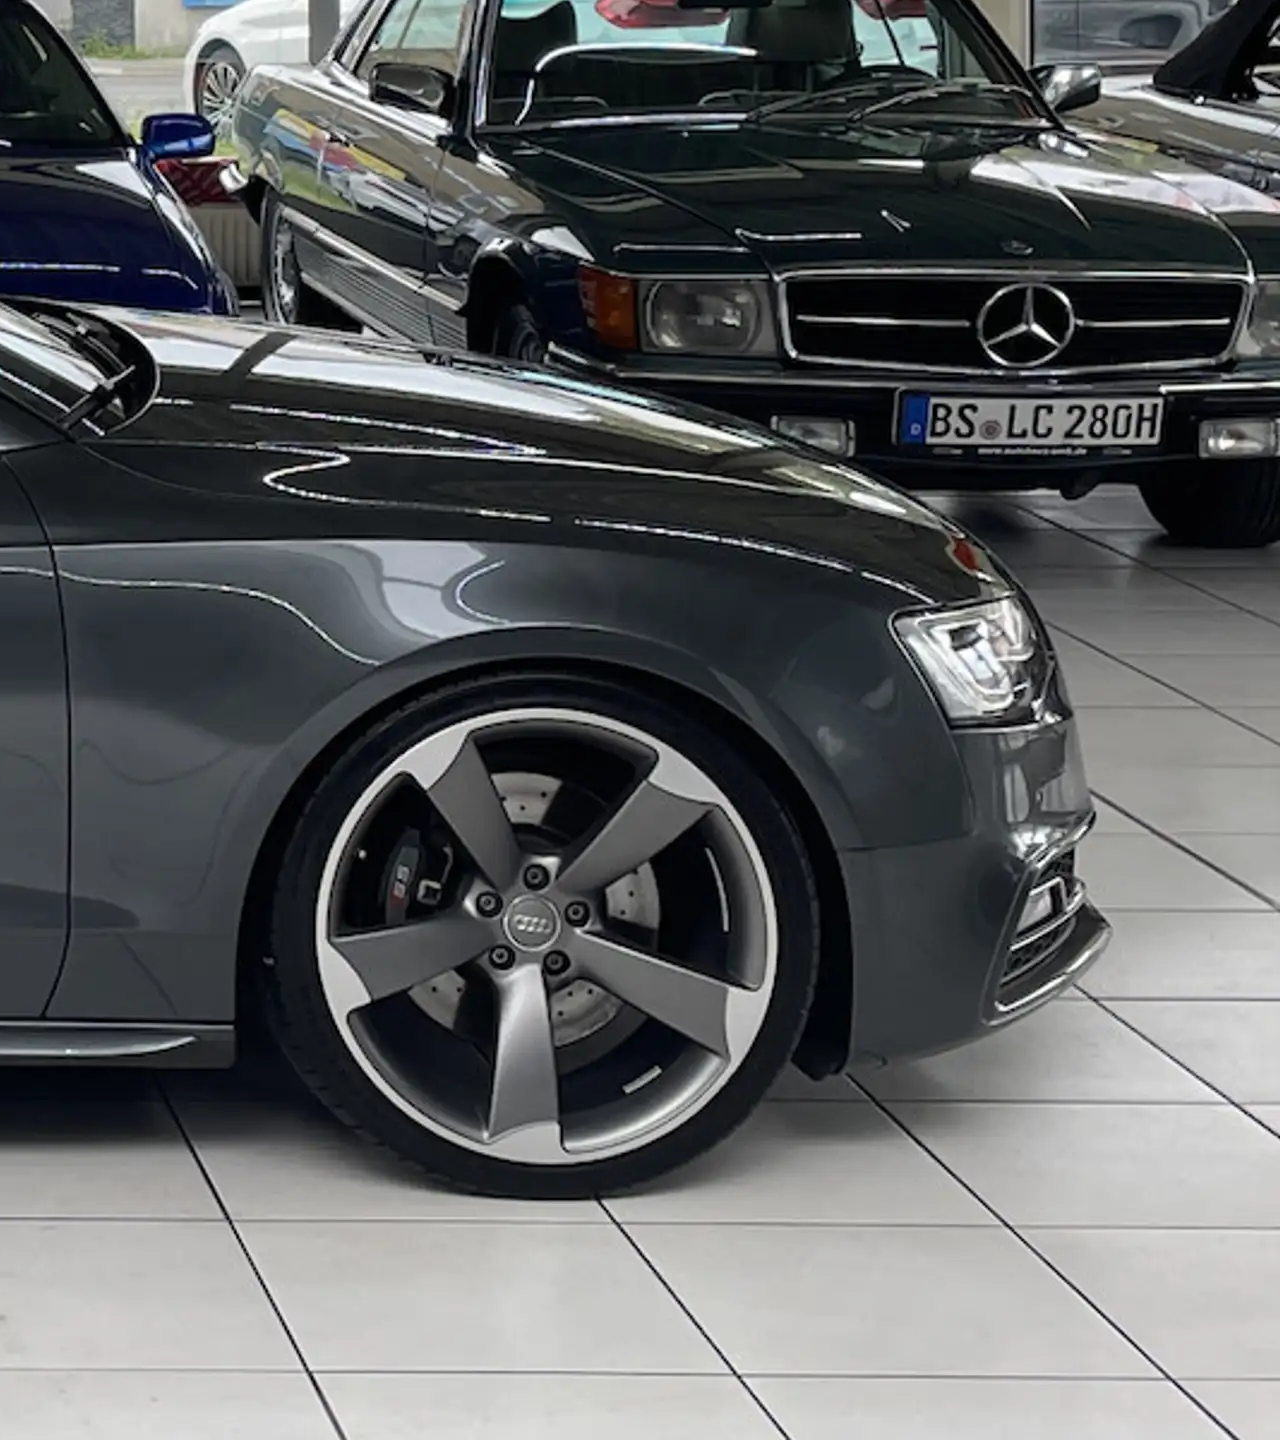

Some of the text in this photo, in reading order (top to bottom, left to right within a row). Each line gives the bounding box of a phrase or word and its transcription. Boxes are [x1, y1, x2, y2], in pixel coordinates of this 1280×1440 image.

[930, 403, 1159, 439] BS LC 280H
